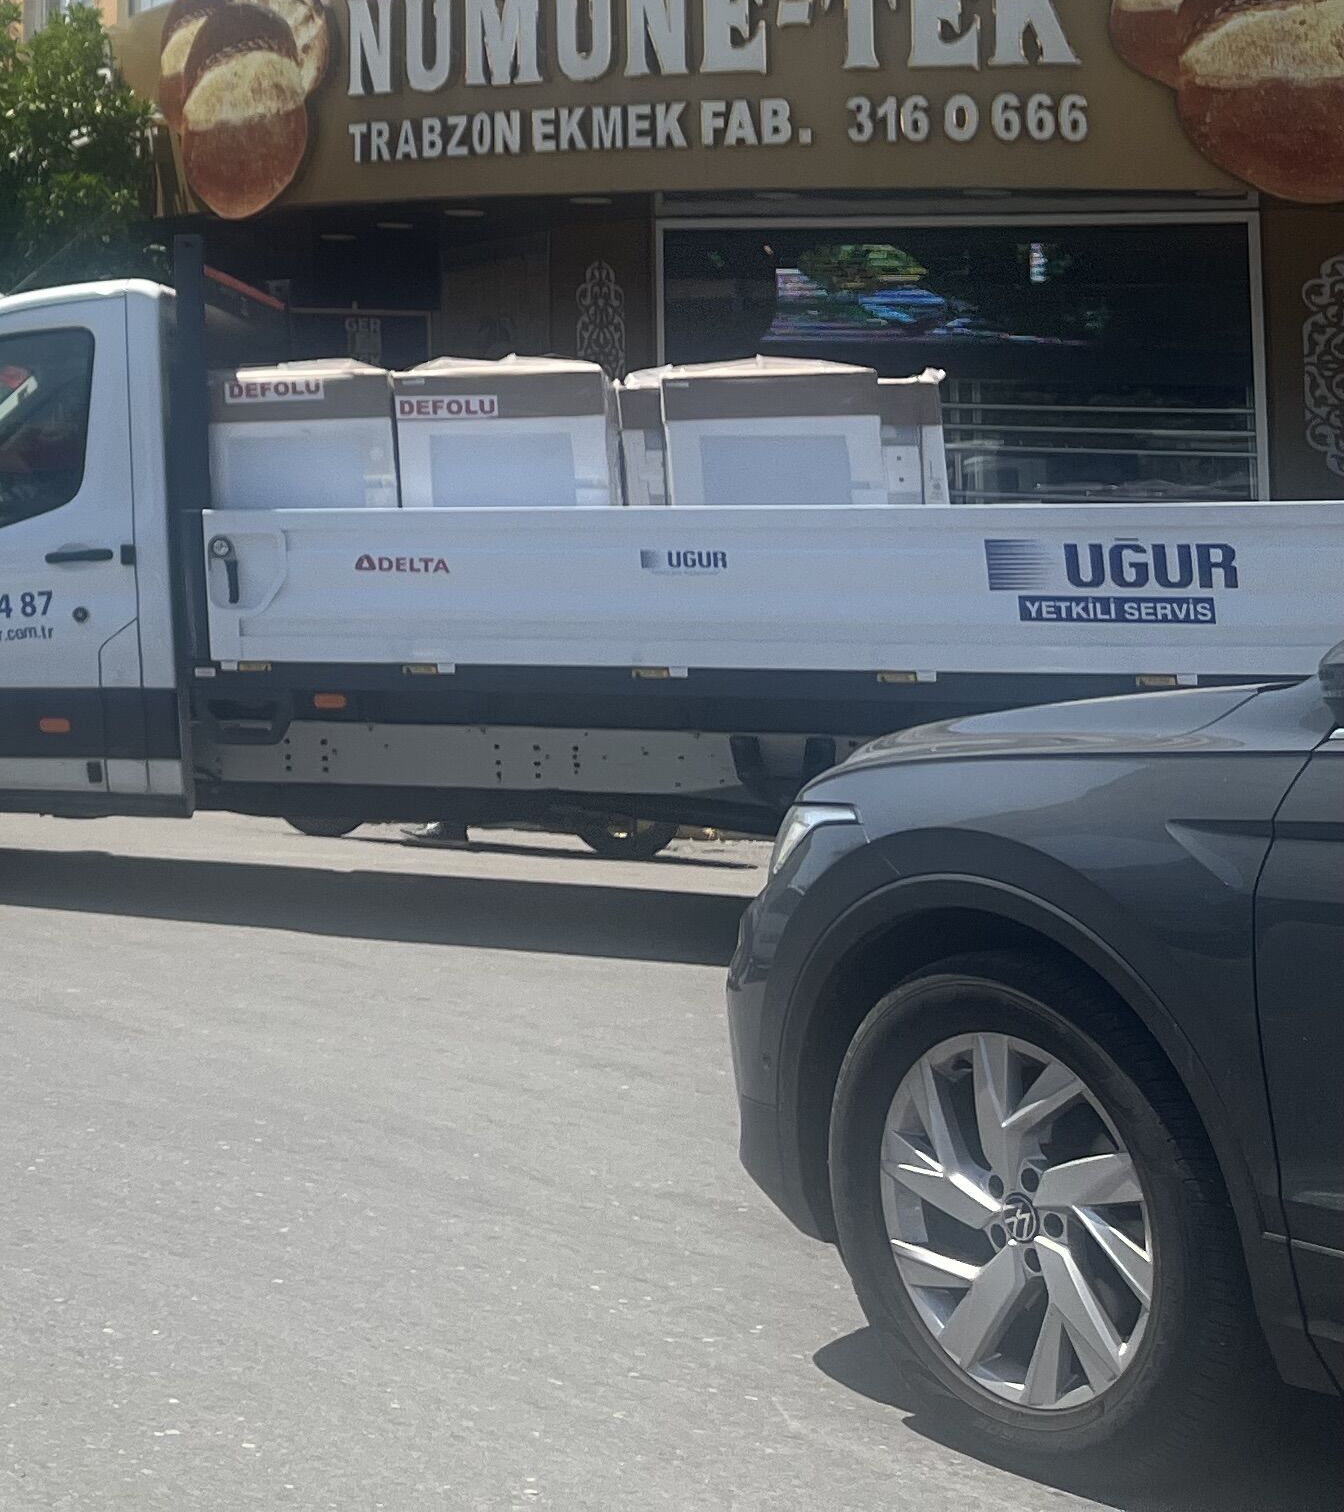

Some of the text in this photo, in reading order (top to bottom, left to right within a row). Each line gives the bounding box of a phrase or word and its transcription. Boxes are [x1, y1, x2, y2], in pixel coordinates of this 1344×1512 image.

[348, 109, 521, 164] TRABZON
[531, 100, 688, 153] EKMEK
[700, 96, 813, 147] FAB.
[846, 94, 930, 143] 316
[991, 92, 1089, 144] 666
[228, 379, 321, 400] DEFOLU
[399, 399, 496, 416] DEFOLU
[377, 556, 450, 574] DELTA
[1063, 537, 1240, 589] UĞUR
[1024, 597, 1213, 621] YETKİLİ SERVİS
